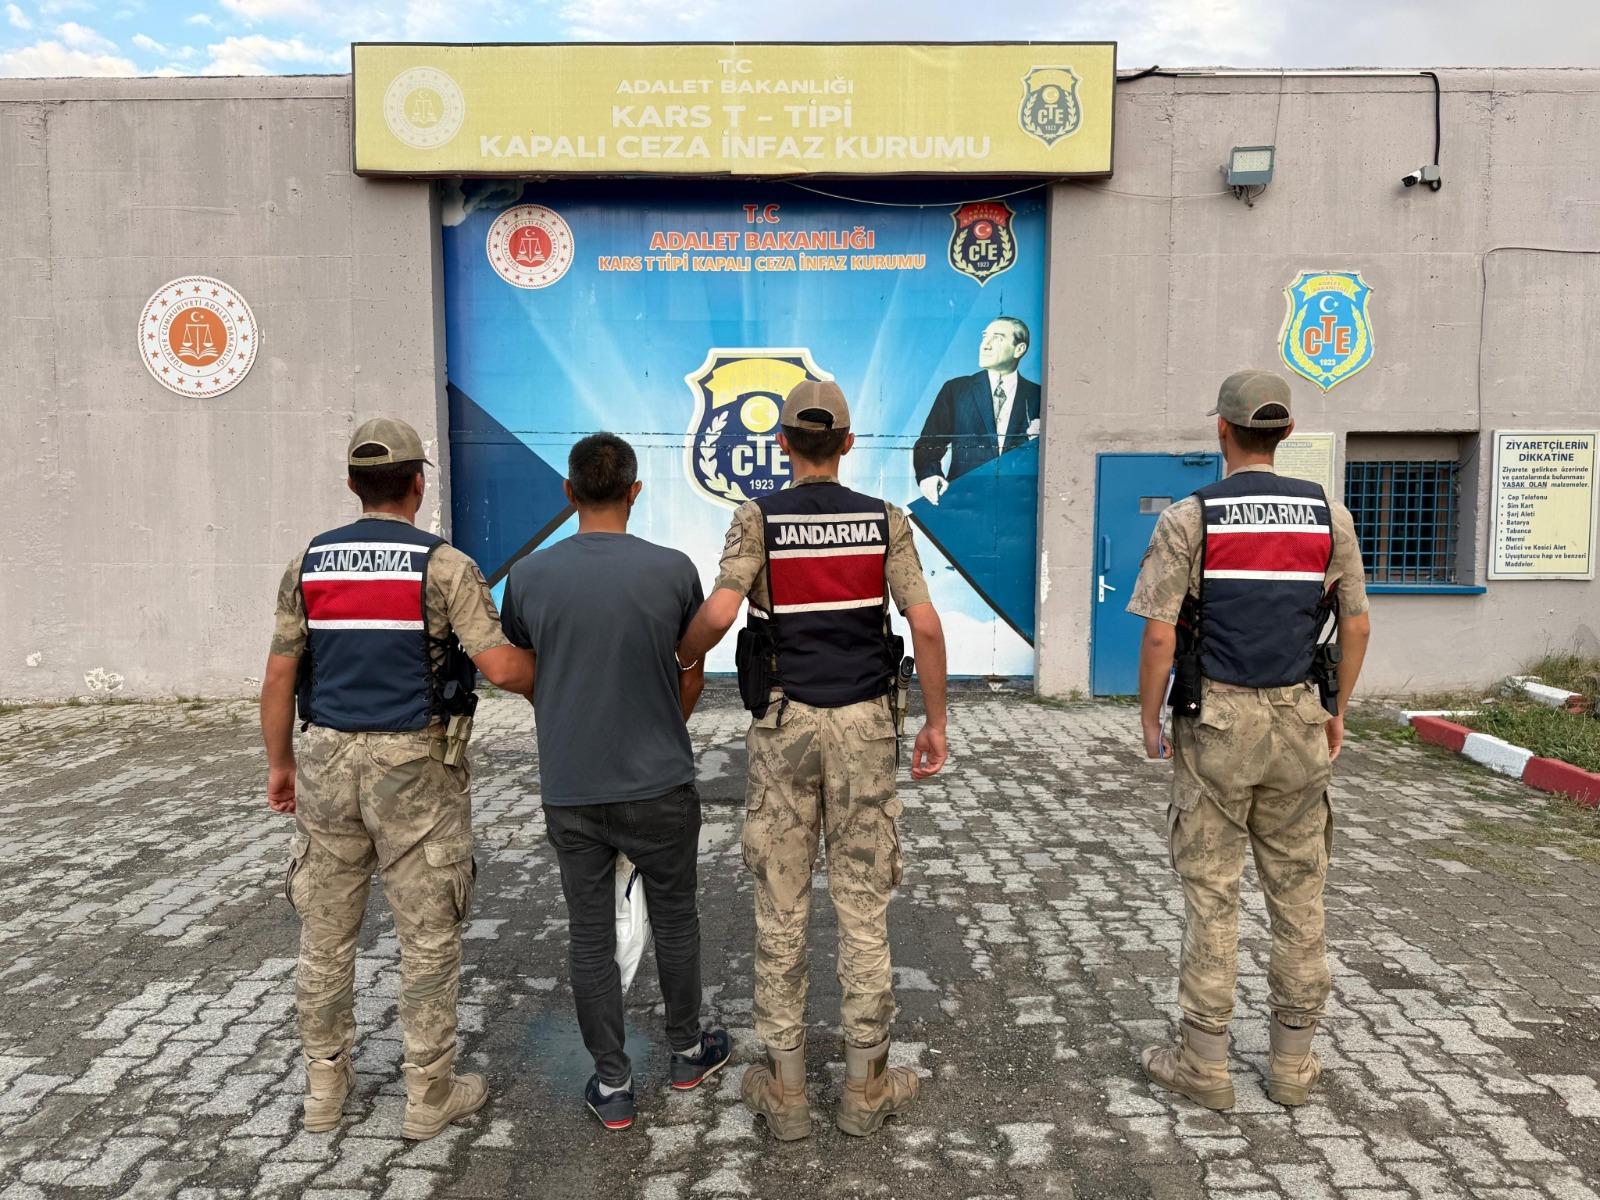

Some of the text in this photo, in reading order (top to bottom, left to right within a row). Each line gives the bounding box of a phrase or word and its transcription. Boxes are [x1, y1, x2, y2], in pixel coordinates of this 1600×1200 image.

[616, 75, 854, 95] ADALET BAKANLIĞI
[611, 104, 713, 128] KARS
[723, 105, 746, 128] T
[783, 99, 852, 129] TİPİ
[1037, 104, 1064, 125] CTE
[479, 129, 991, 160] KAPALI CEZA İNFAZ KURUMU
[743, 203, 781, 224] T.C
[649, 226, 875, 251] ADALET BAKANLIĞI
[968, 239, 998, 261] CTE
[598, 255, 642, 272] KARS
[692, 255, 752, 272] KAPALI
[755, 256, 796, 272] CEZA
[799, 252, 847, 271] İNFAZ
[851, 254, 926, 271] KURUMU
[161, 299, 202, 336] CUMHURİYETİ
[204, 302, 230, 324] ADALET
[1303, 315, 1352, 356] CTE
[731, 435, 790, 477] CTE
[1505, 440, 1589, 453] ZİYARETÇİLERİN
[1518, 452, 1575, 462] DİKKATİNE
[1502, 466, 1528, 474] Ziyarete
[1531, 466, 1558, 474] gelirken
[749, 479, 774, 490] 1923
[1219, 503, 1318, 525] JANDARMA
[1506, 519, 1530, 527] Batarya
[1507, 511, 1519, 519] Şarj
[774, 522, 882, 545] JANDARMA
[313, 550, 413, 572] JANDARMA
